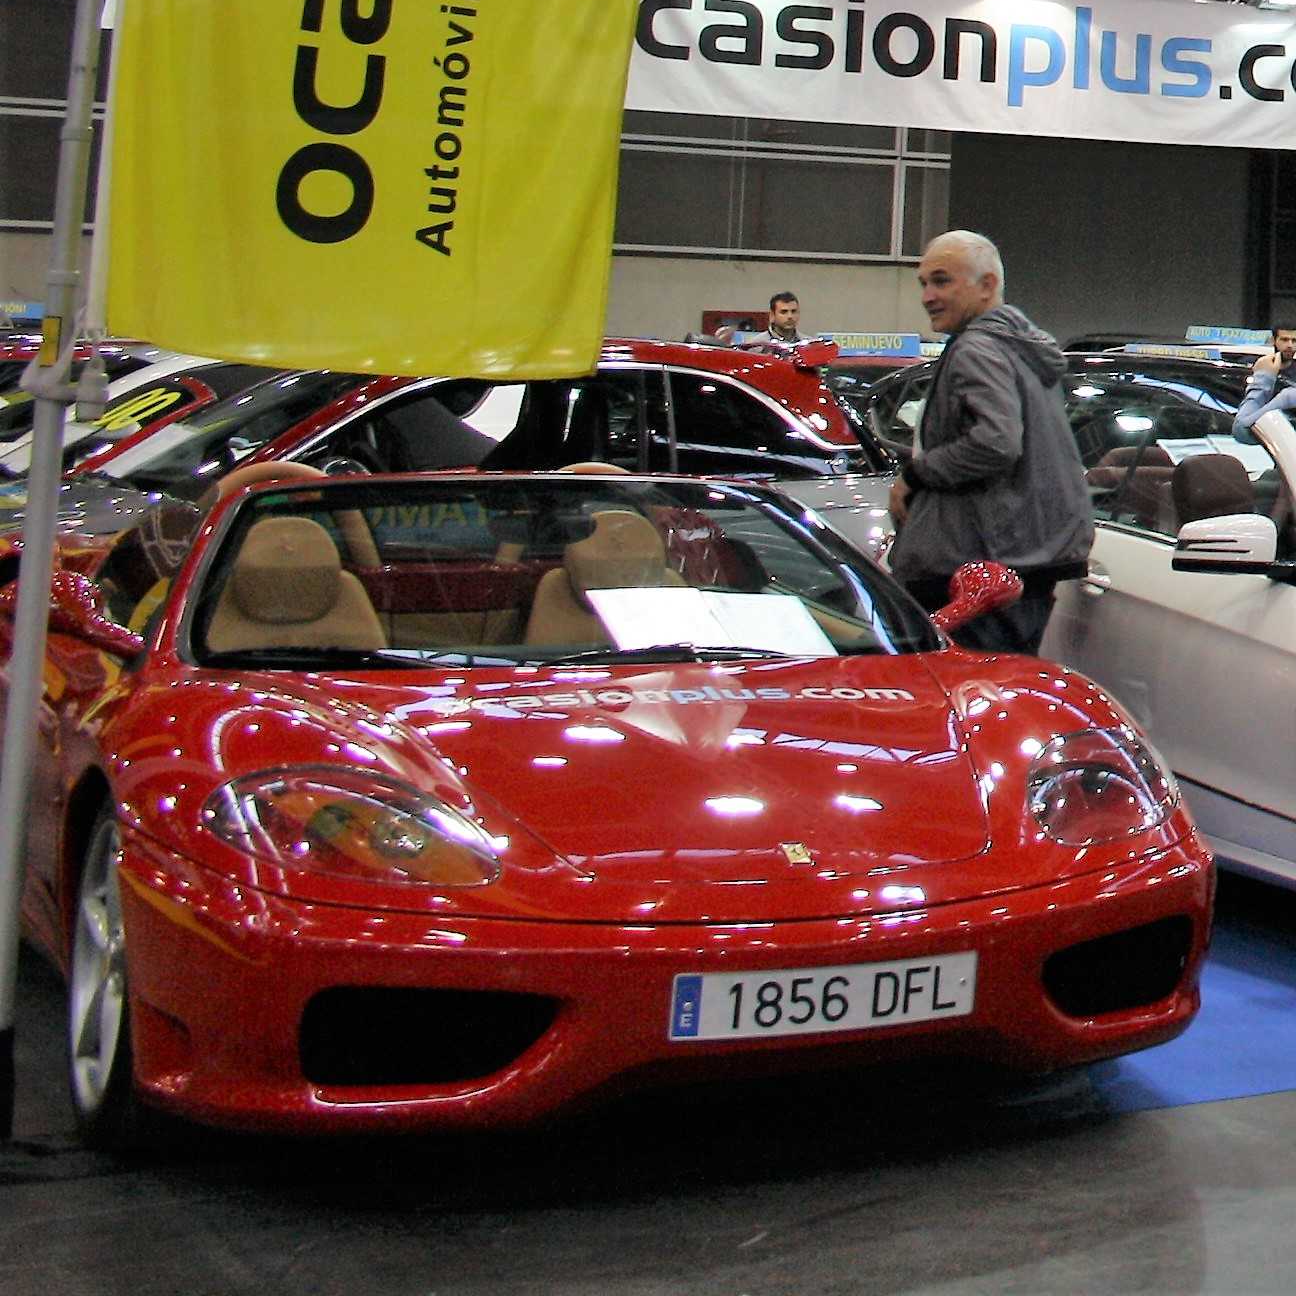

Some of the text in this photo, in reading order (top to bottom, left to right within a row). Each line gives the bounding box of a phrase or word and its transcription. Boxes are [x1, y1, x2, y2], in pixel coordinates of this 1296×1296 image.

[833, 334, 902, 350] SEMINUEVO
[729, 965, 957, 1030] 1856 DFL
